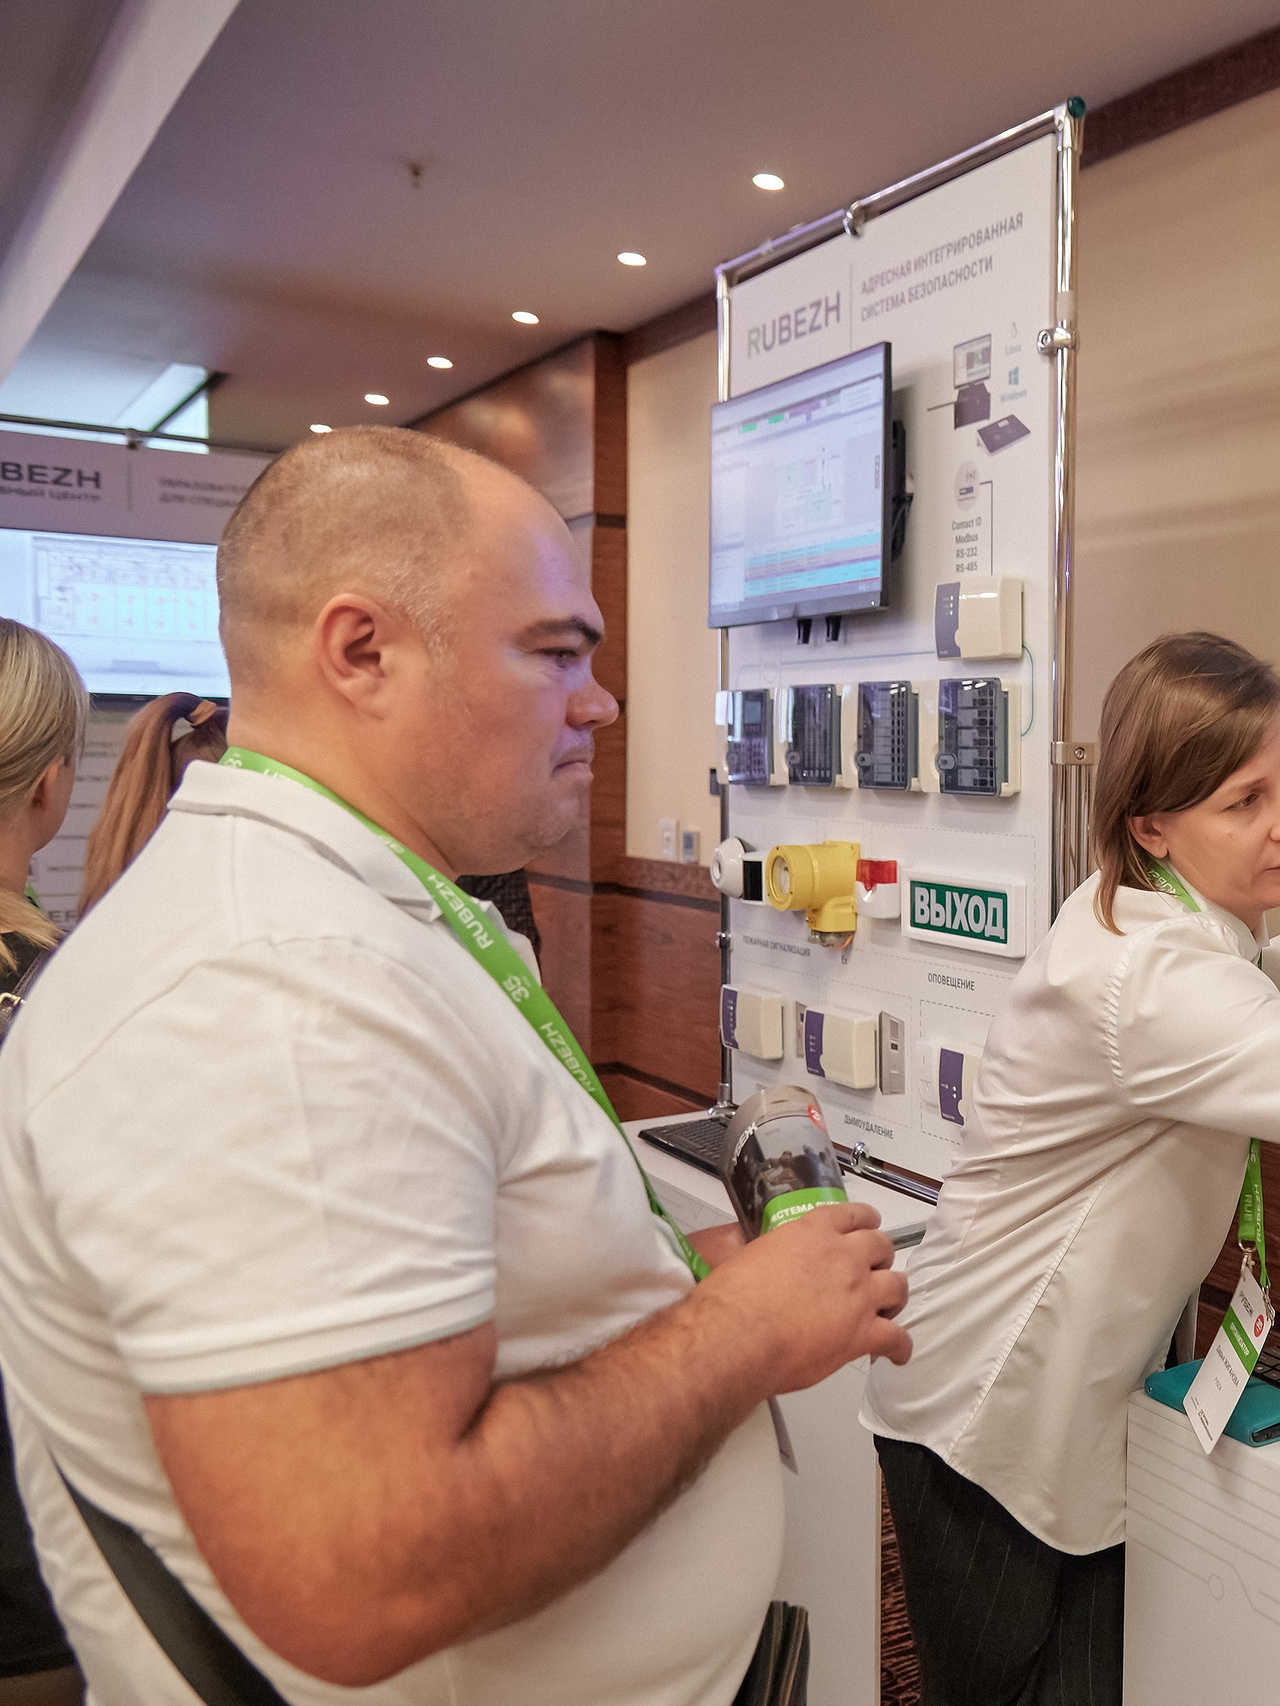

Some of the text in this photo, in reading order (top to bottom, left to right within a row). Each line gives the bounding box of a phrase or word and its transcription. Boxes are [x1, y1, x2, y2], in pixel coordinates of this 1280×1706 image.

[861, 212, 1024, 296] АДРЕСНАЯ ИНТЕГРИРОВАННАЯ
[860, 255, 993, 322] СИСТЕМА БЕЗОПАСНОСТИ
[746, 291, 841, 360] RUBEZH
[951, 516, 983, 531] Contact ID
[955, 532, 979, 545] Modbus
[955, 546, 978, 559] RS-232
[955, 560, 978, 573] RS-485
[428, 874, 494, 950] RUBEZH
[914, 886, 1006, 940] ВЫХОД
[927, 972, 975, 991] ОПОВЕЩЕНИЕ
[540, 1021, 597, 1093] RUBEZH
[844, 1114, 894, 1140] ДЫМОУДАЛЕНИЕ
